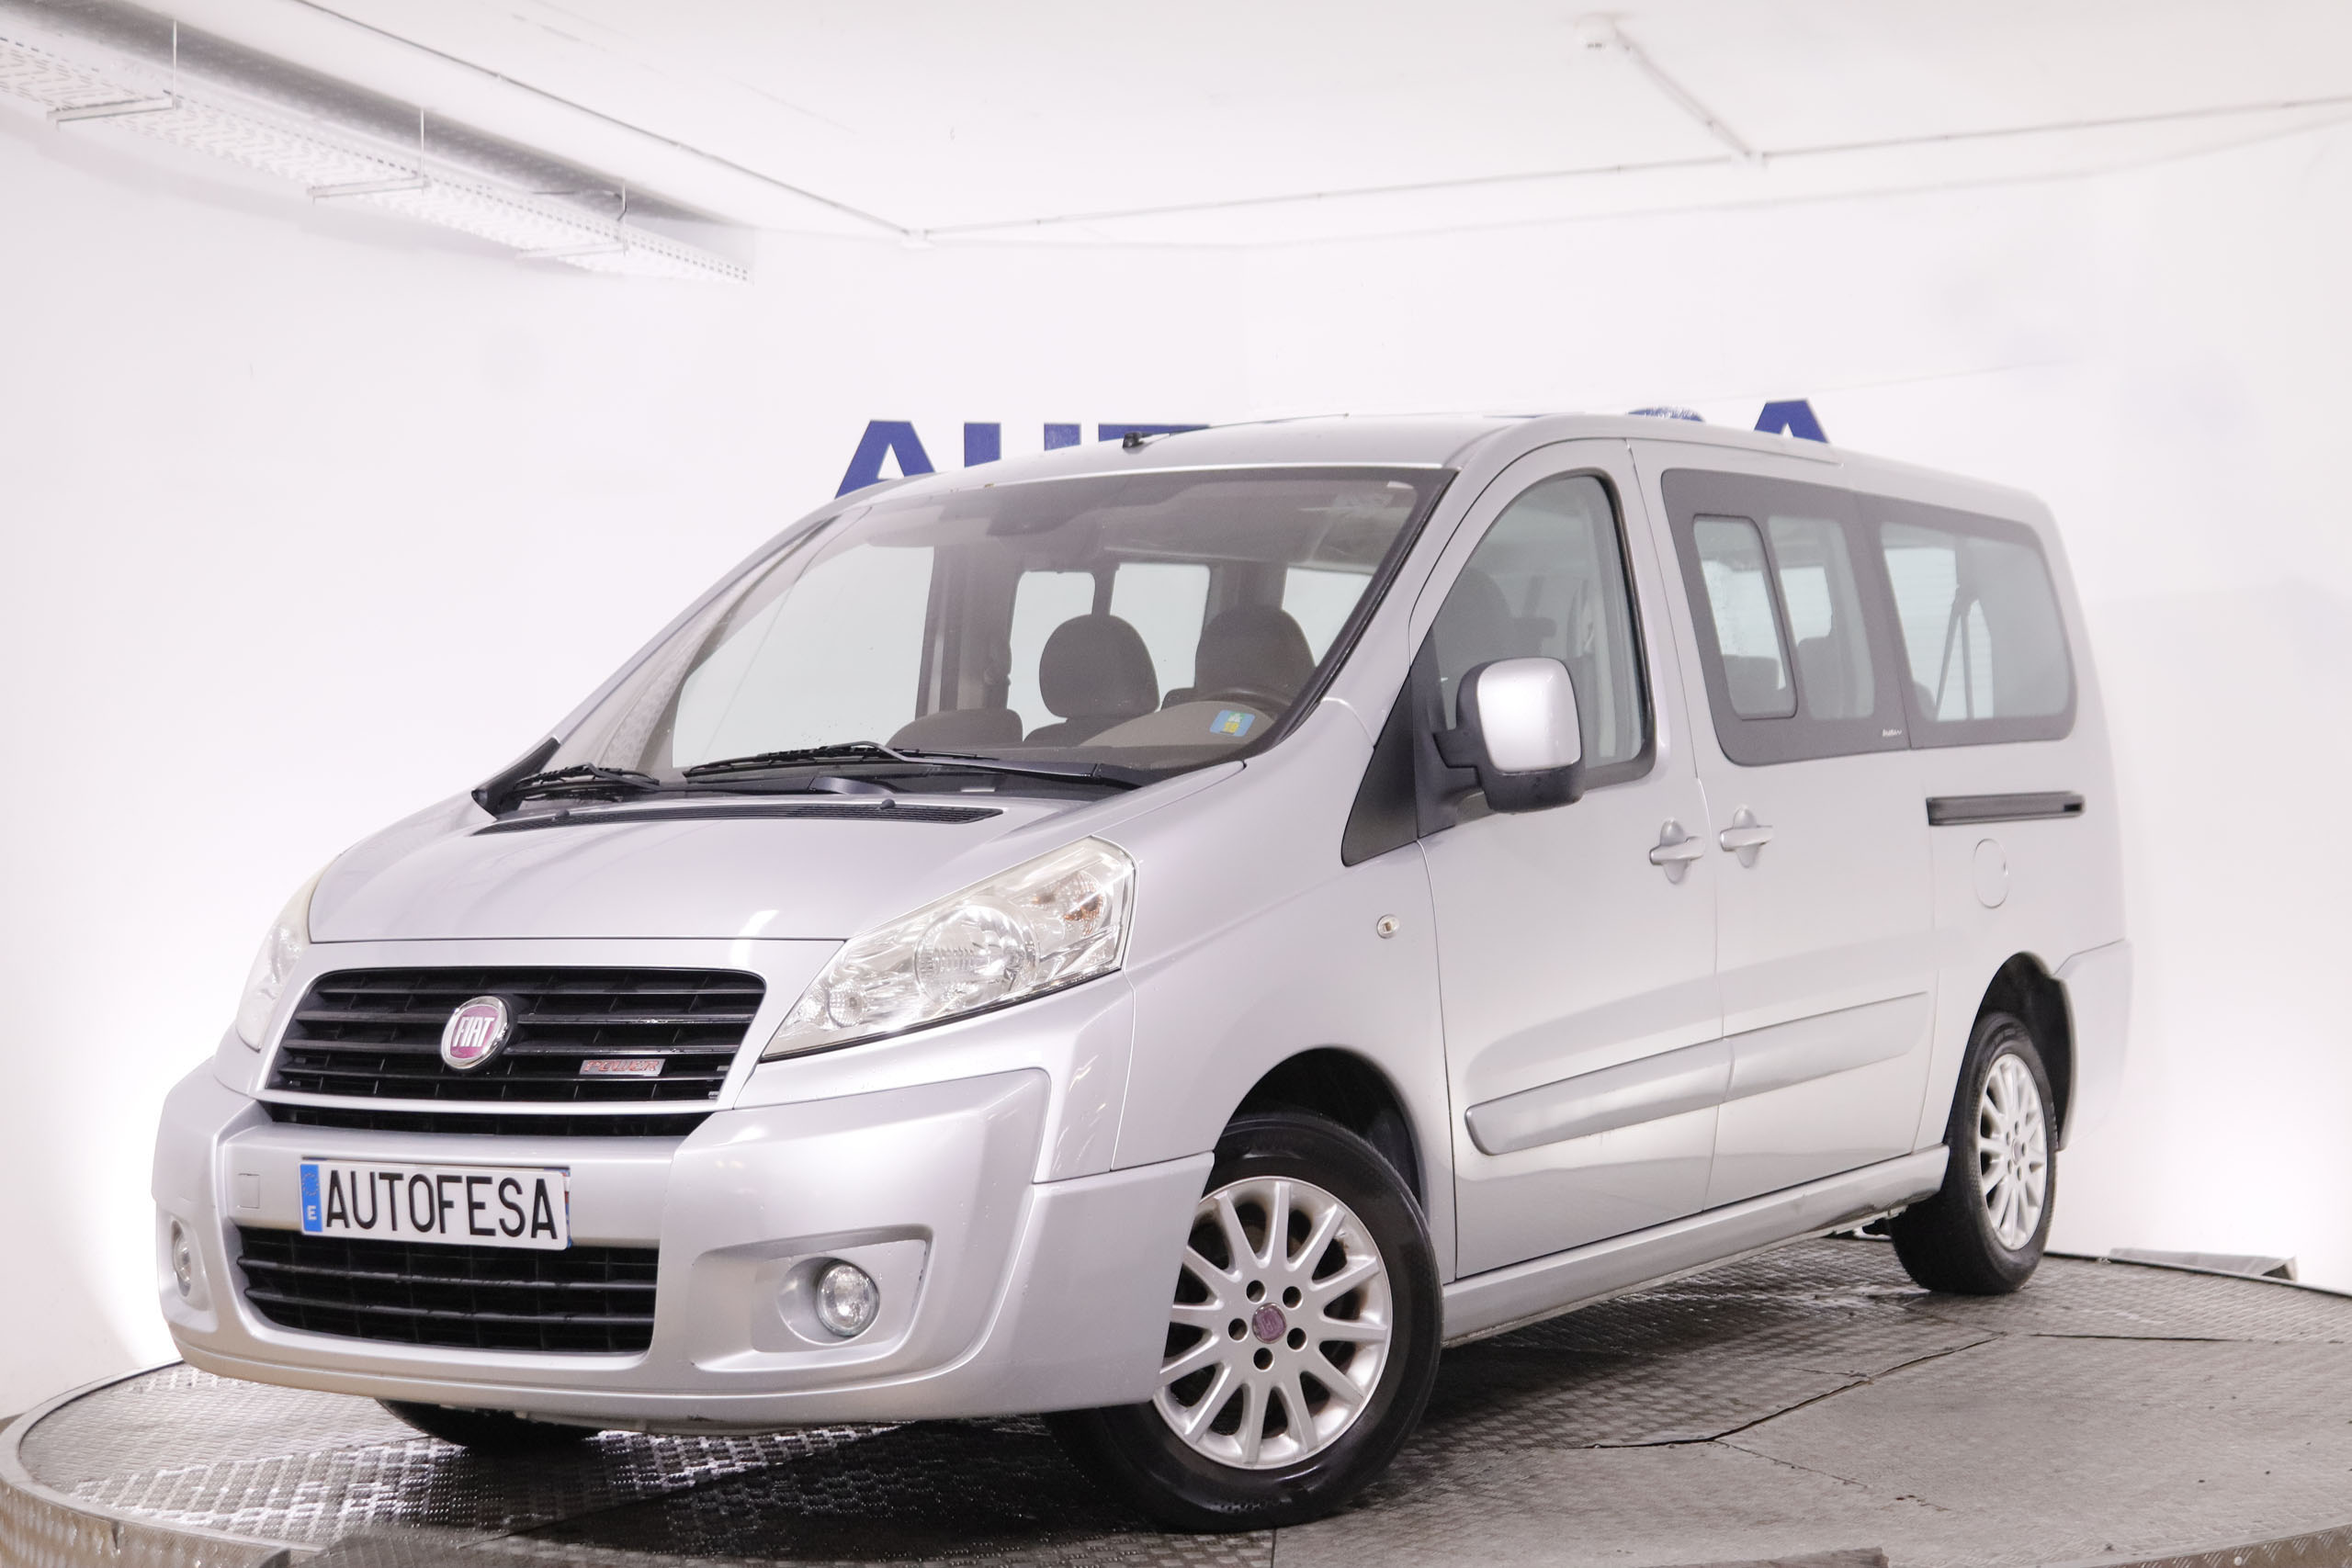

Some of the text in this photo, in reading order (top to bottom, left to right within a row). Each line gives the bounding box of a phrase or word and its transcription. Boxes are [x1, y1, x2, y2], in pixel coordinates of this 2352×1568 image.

[452, 1016, 495, 1047] FIAT
[307, 1169, 558, 1240] E AUTOFESA
